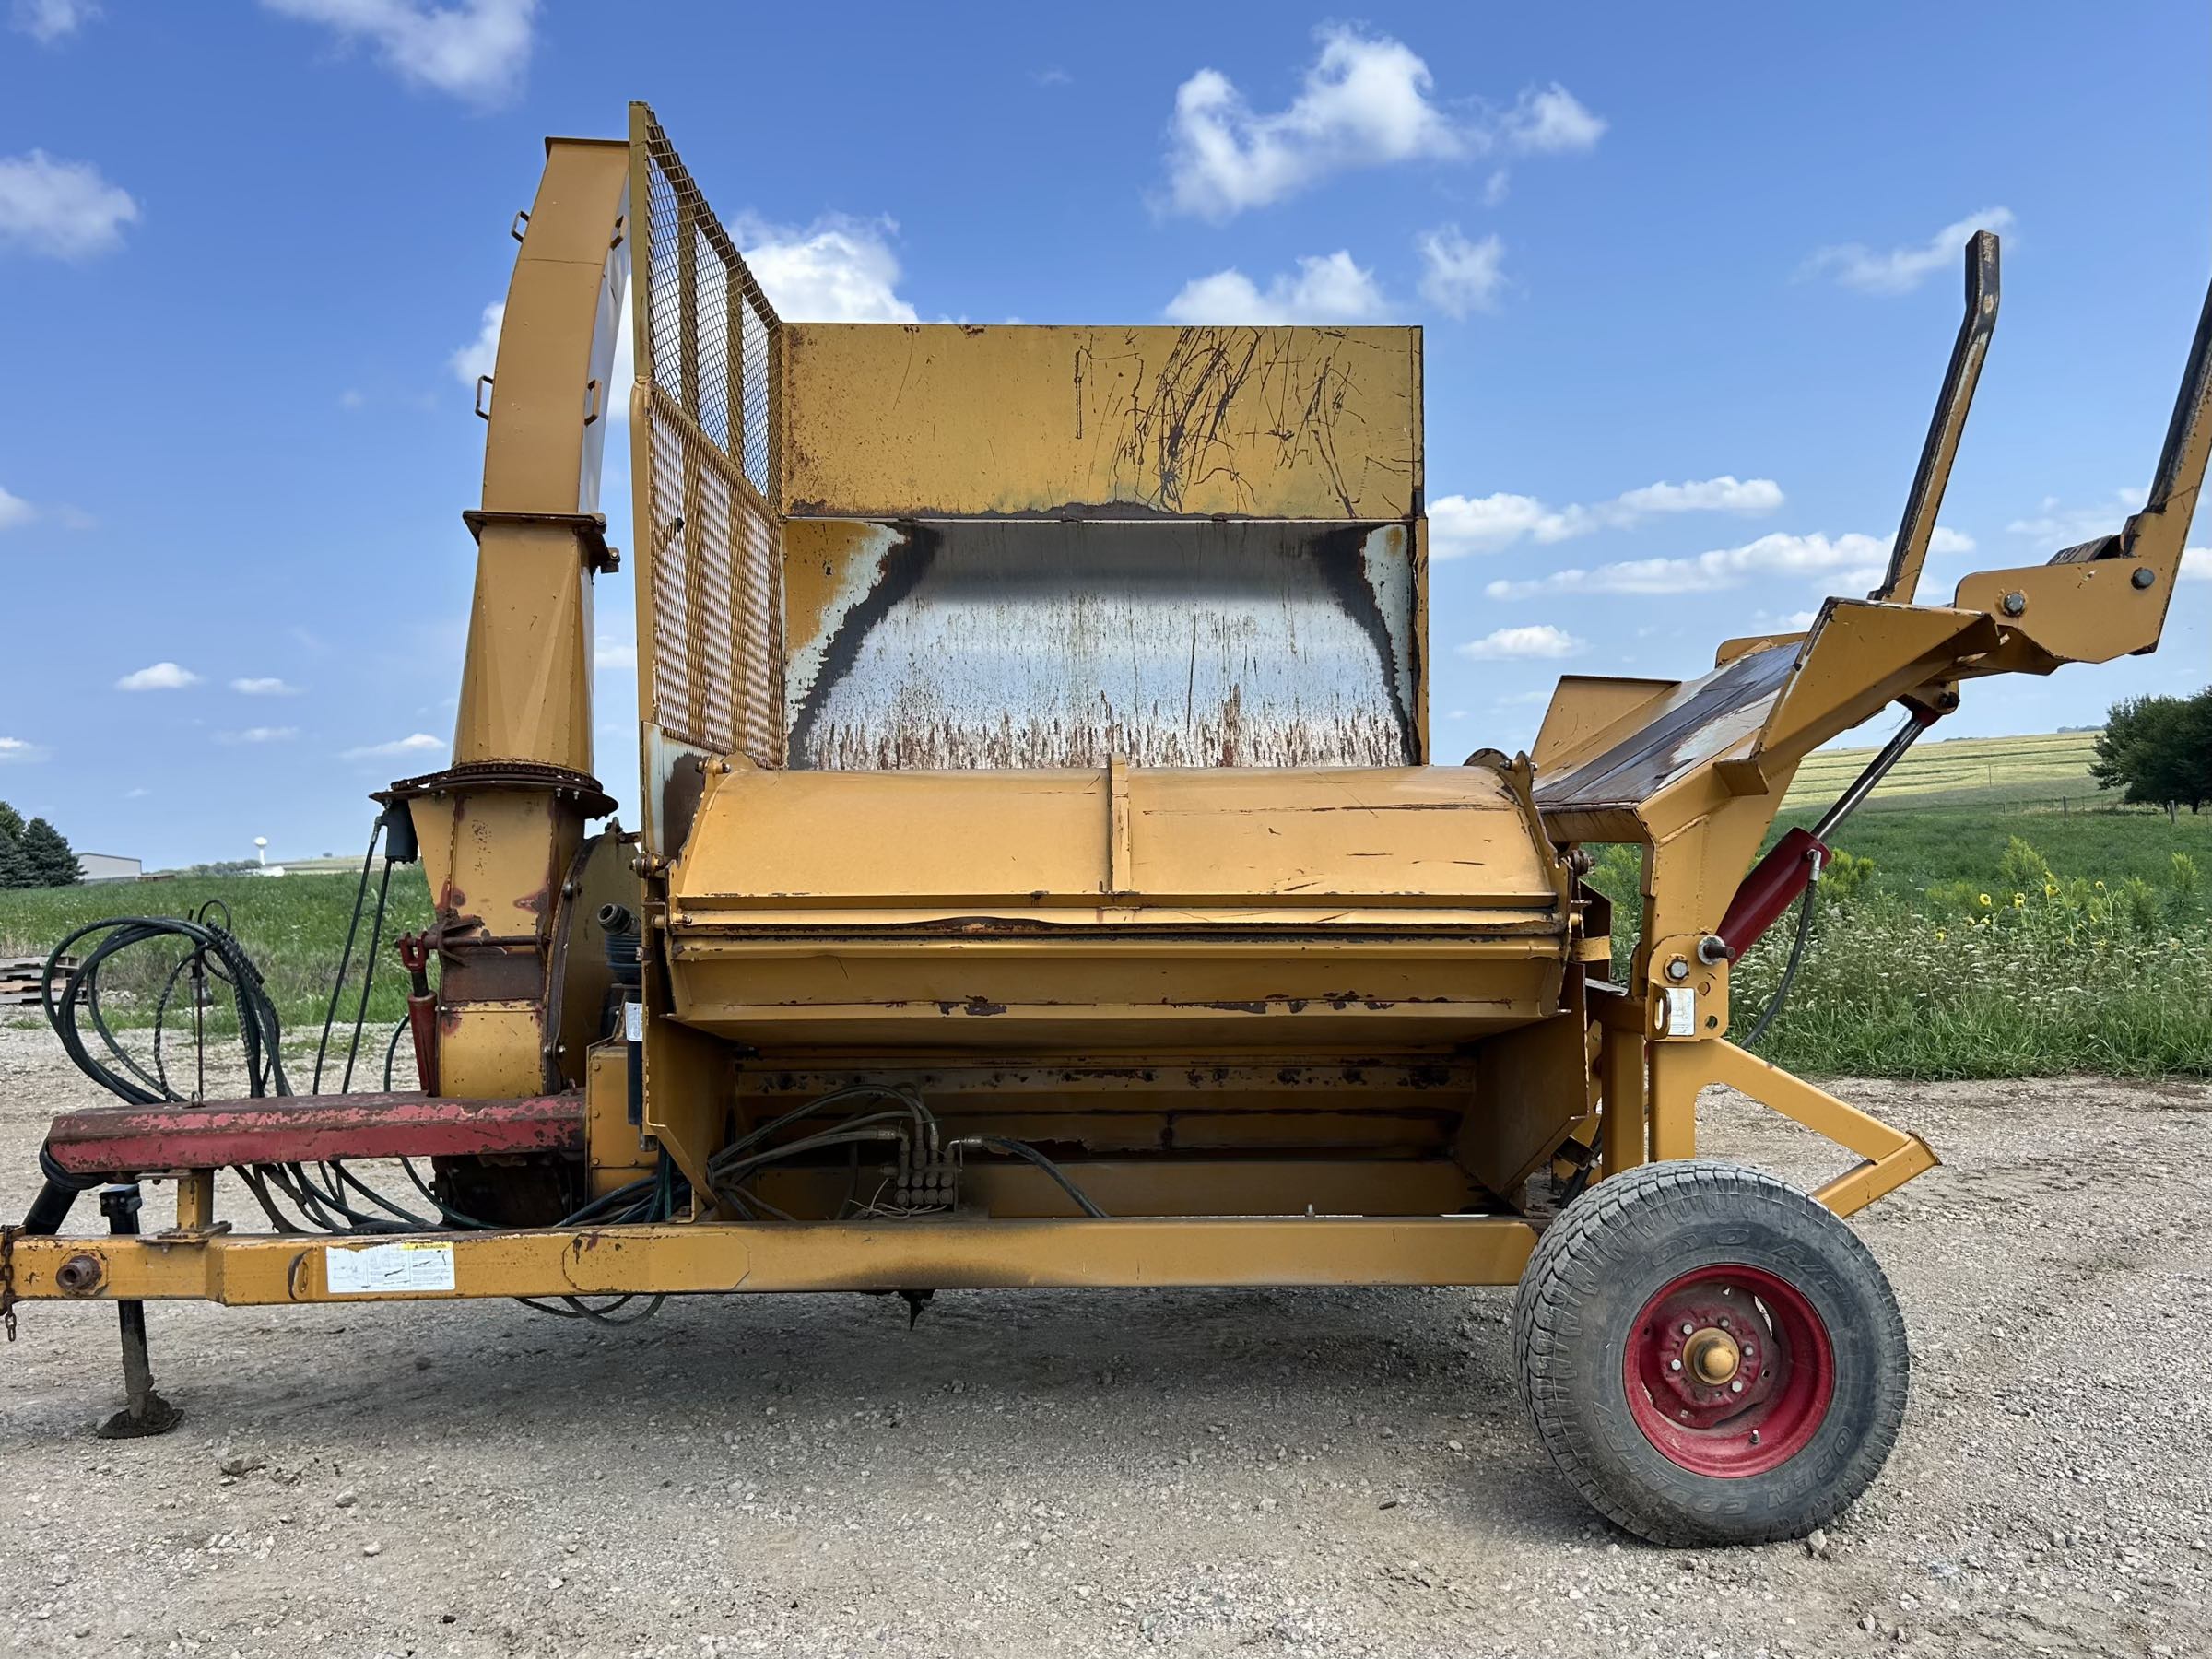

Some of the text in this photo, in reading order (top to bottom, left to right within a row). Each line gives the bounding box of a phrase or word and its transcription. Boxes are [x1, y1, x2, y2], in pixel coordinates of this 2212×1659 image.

[1621, 1229, 1845, 1292] TOYO A/T
[1593, 1401, 1851, 1513] OPEN COUNTRY
